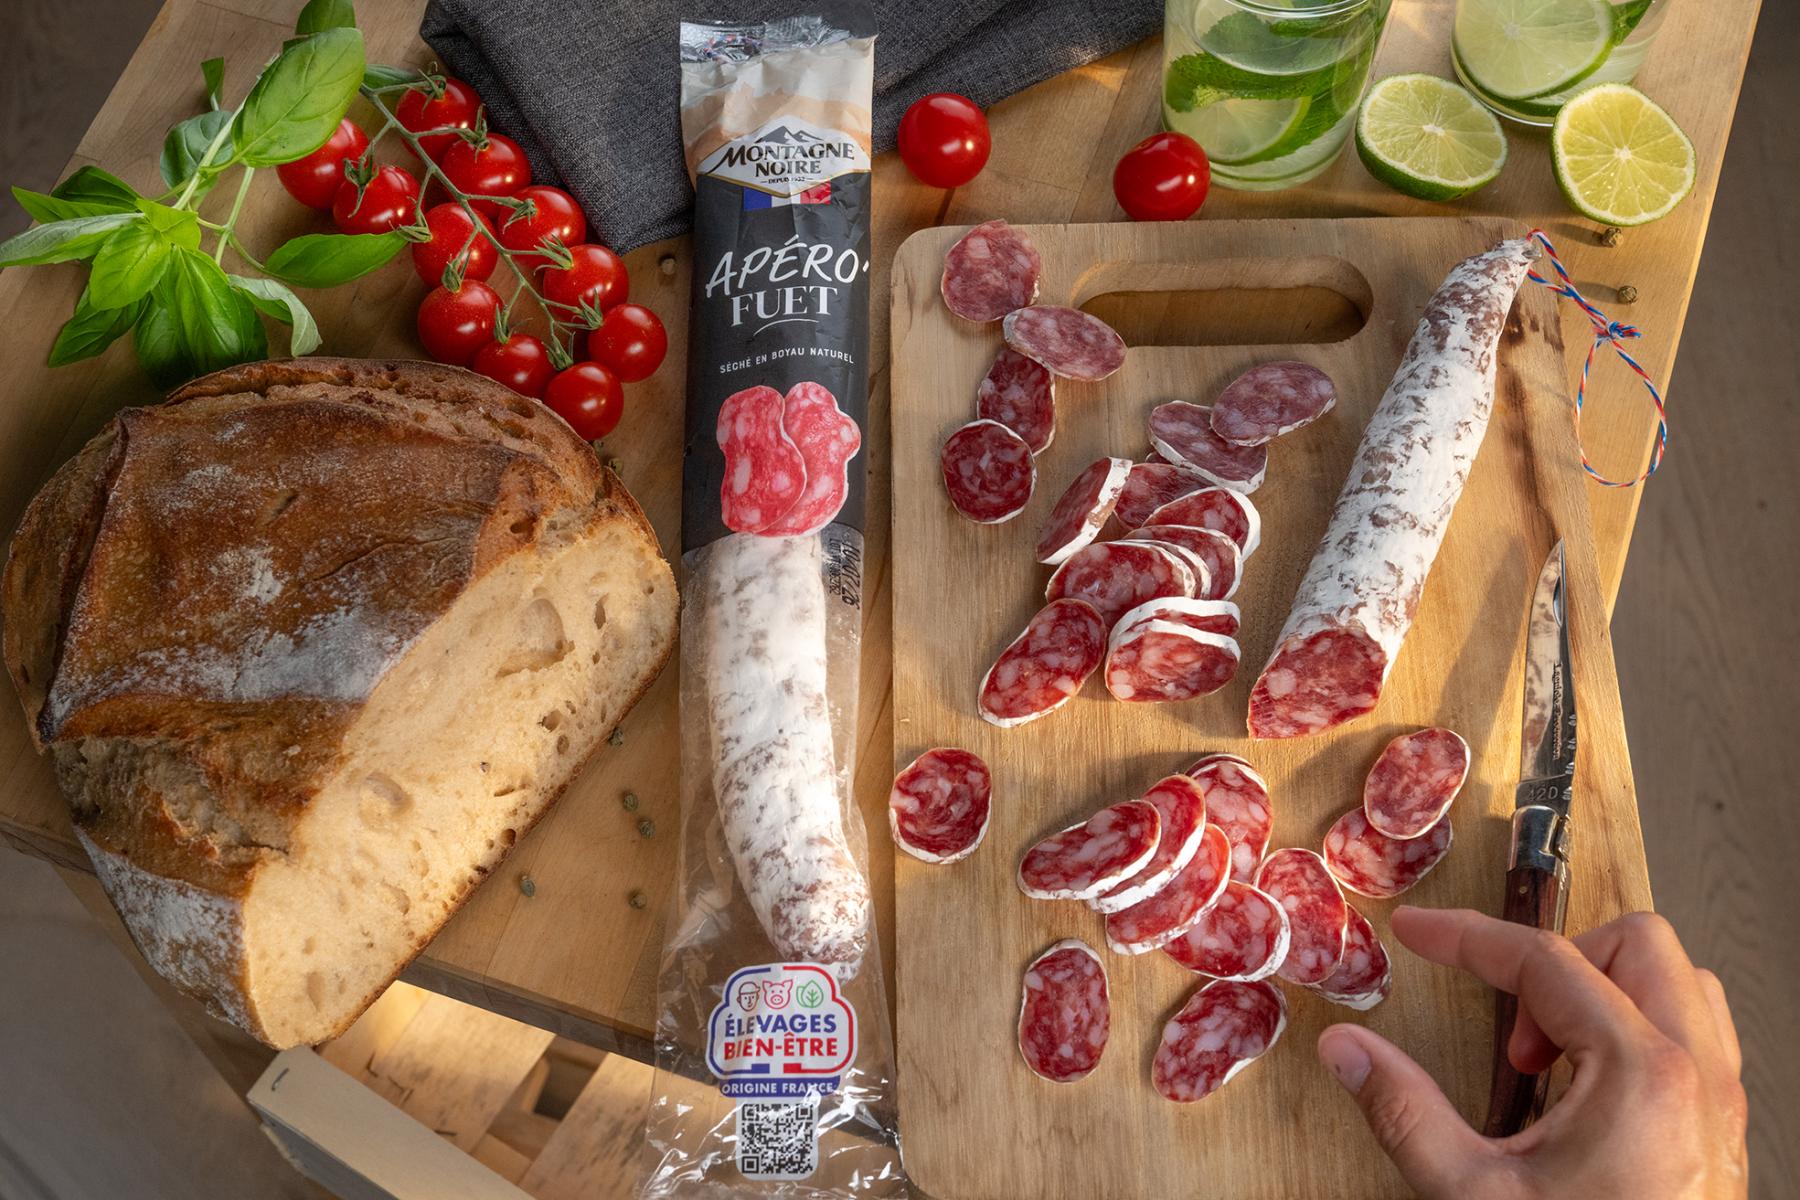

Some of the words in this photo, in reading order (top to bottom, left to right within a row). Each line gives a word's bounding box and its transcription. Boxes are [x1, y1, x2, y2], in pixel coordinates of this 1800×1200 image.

[708, 143, 855, 175] MONTAGNE
[755, 160, 822, 177] NOIRE
[731, 286, 838, 327] FUET
[755, 354, 767, 365] EN
[771, 347, 805, 360] BOYAU
[810, 347, 855, 364] NATUREL
[725, 1013, 837, 1038] ÉLEVAGES
[724, 1032, 838, 1060] BIEN-ÊTRE
[721, 1083, 777, 1094] ORIGINE
